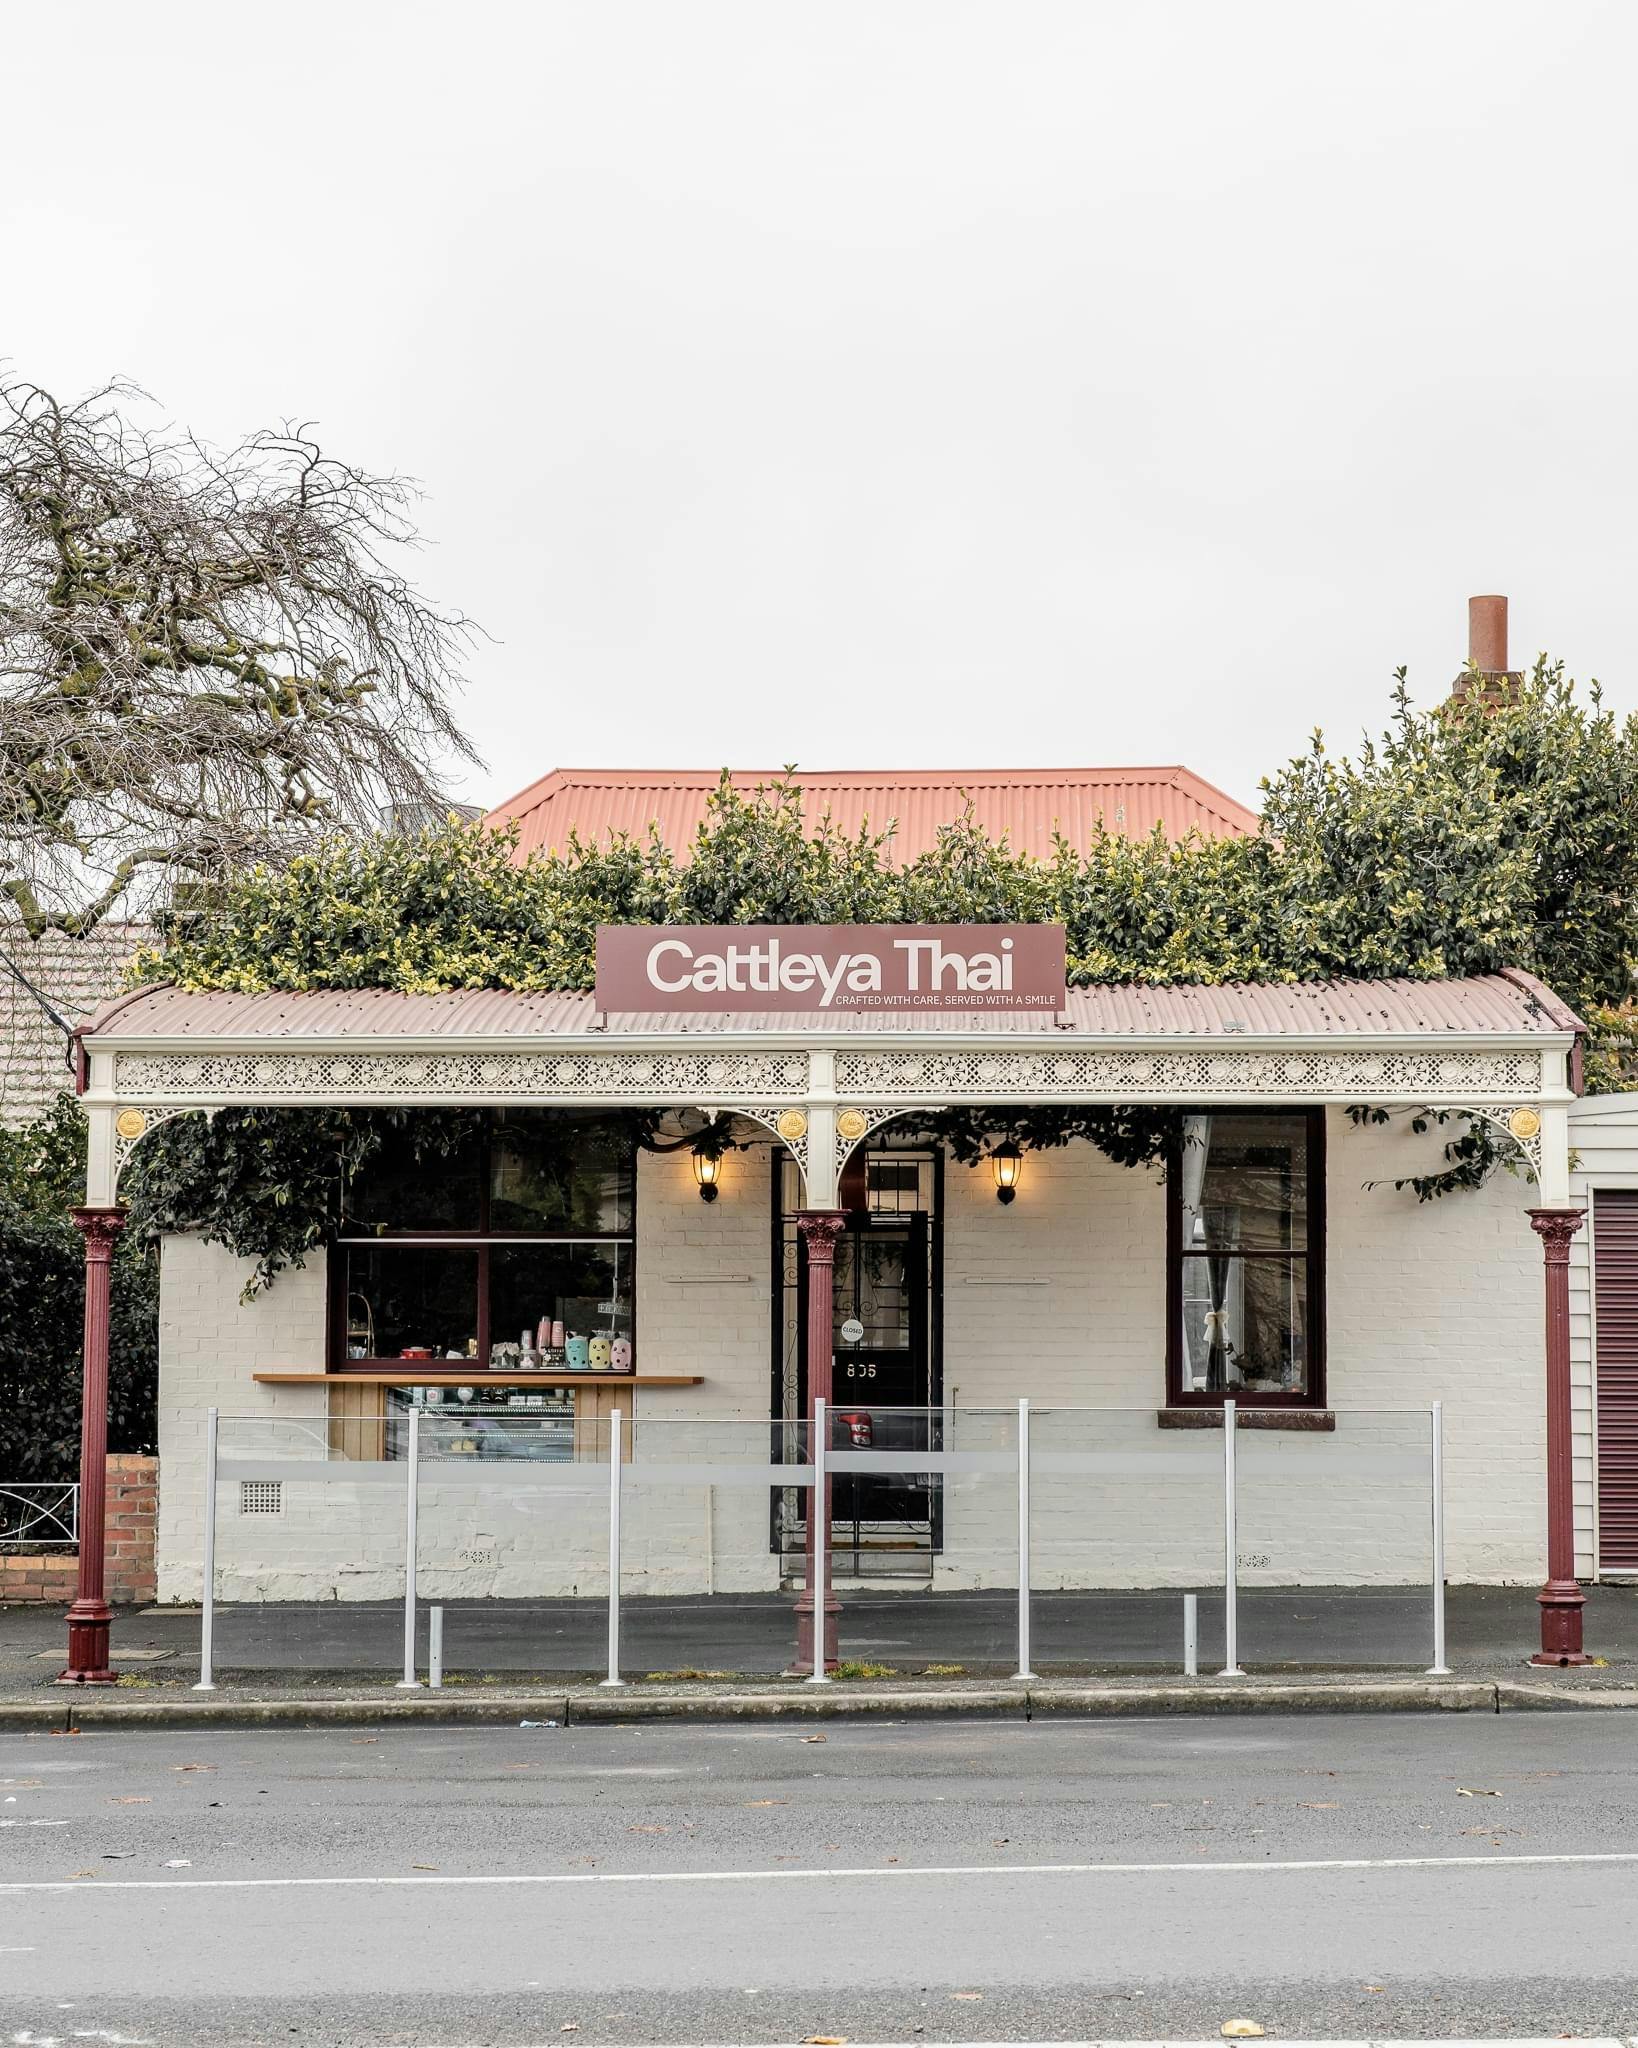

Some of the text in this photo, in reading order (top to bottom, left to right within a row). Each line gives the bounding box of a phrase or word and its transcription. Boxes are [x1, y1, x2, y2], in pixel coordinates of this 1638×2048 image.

[646, 939, 1014, 1007] Cattleya Thai
[835, 995, 1056, 1006] CRAFTED WITH CARE, SERVED WITH A SMILE
[842, 1326, 863, 1335] CLOSED
